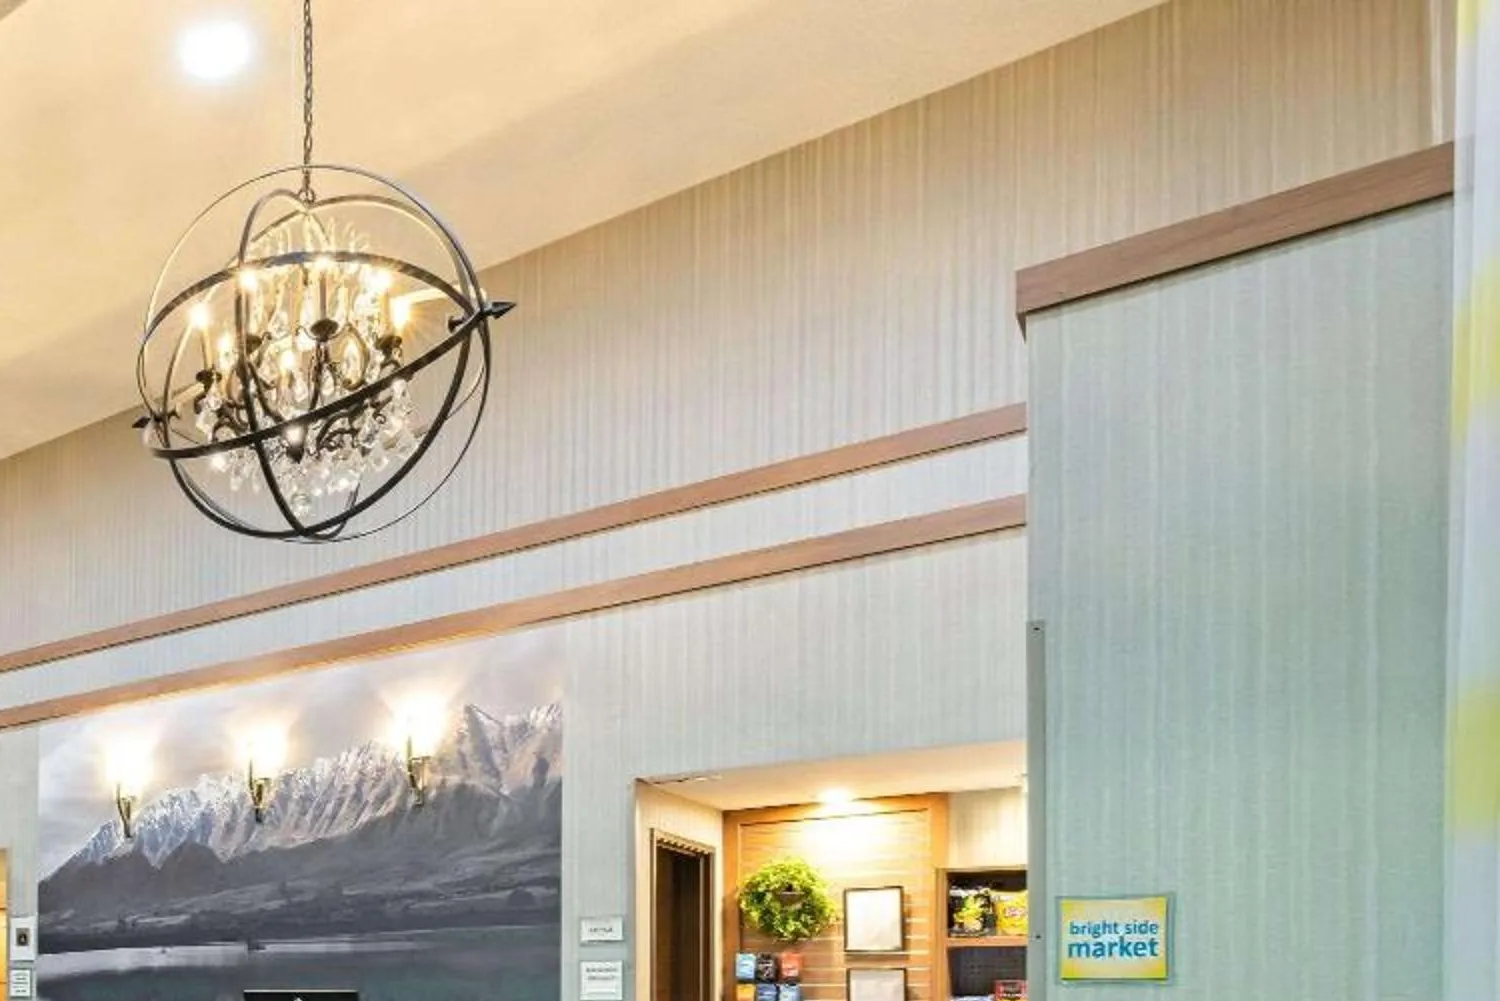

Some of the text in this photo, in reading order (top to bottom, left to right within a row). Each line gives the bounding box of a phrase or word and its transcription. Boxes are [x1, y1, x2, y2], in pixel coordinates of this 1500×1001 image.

[1070, 920, 1158, 938] bright side
[1068, 937, 1158, 958] market
